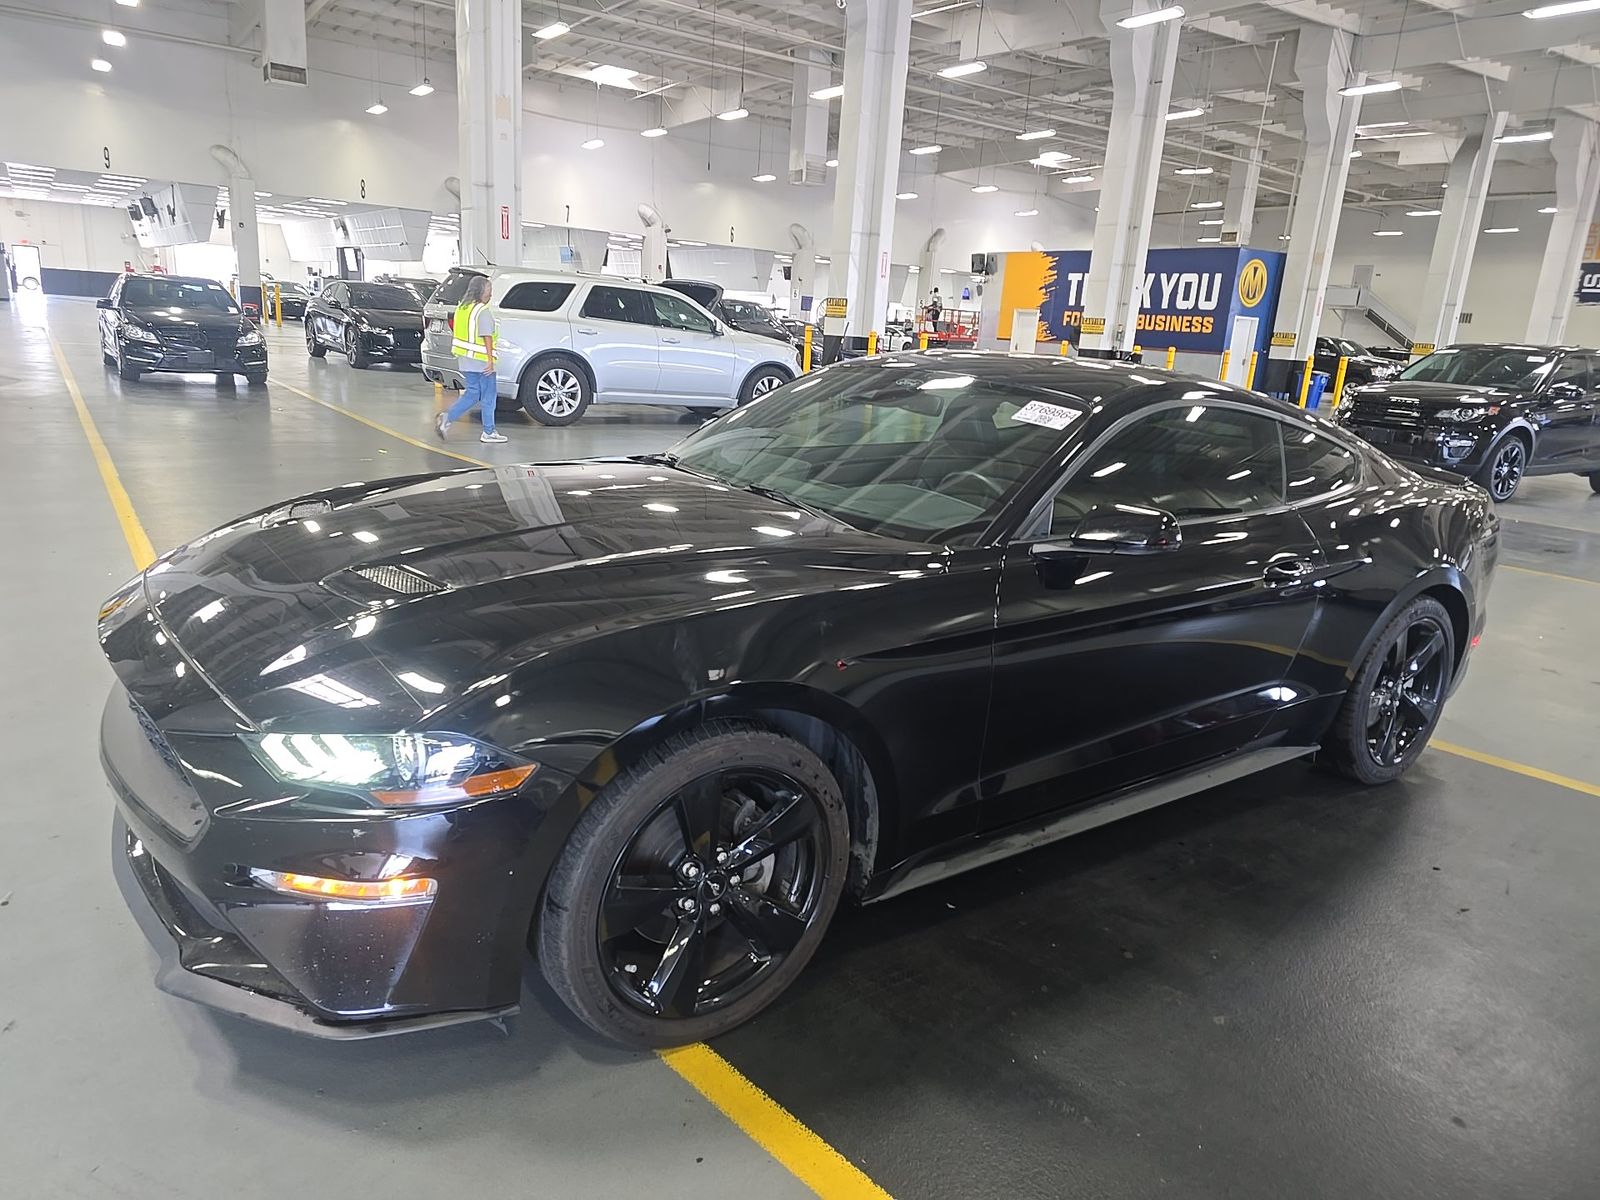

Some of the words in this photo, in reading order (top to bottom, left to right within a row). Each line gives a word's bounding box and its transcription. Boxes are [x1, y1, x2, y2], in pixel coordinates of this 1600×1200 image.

[104, 146, 110, 169] 9
[360, 179, 366, 199] 8
[730, 226, 735, 243] 6
[1160, 272, 1222, 310] YOU
[1063, 310, 1082, 327] FO
[1136, 314, 1214, 333] BUSINESS
